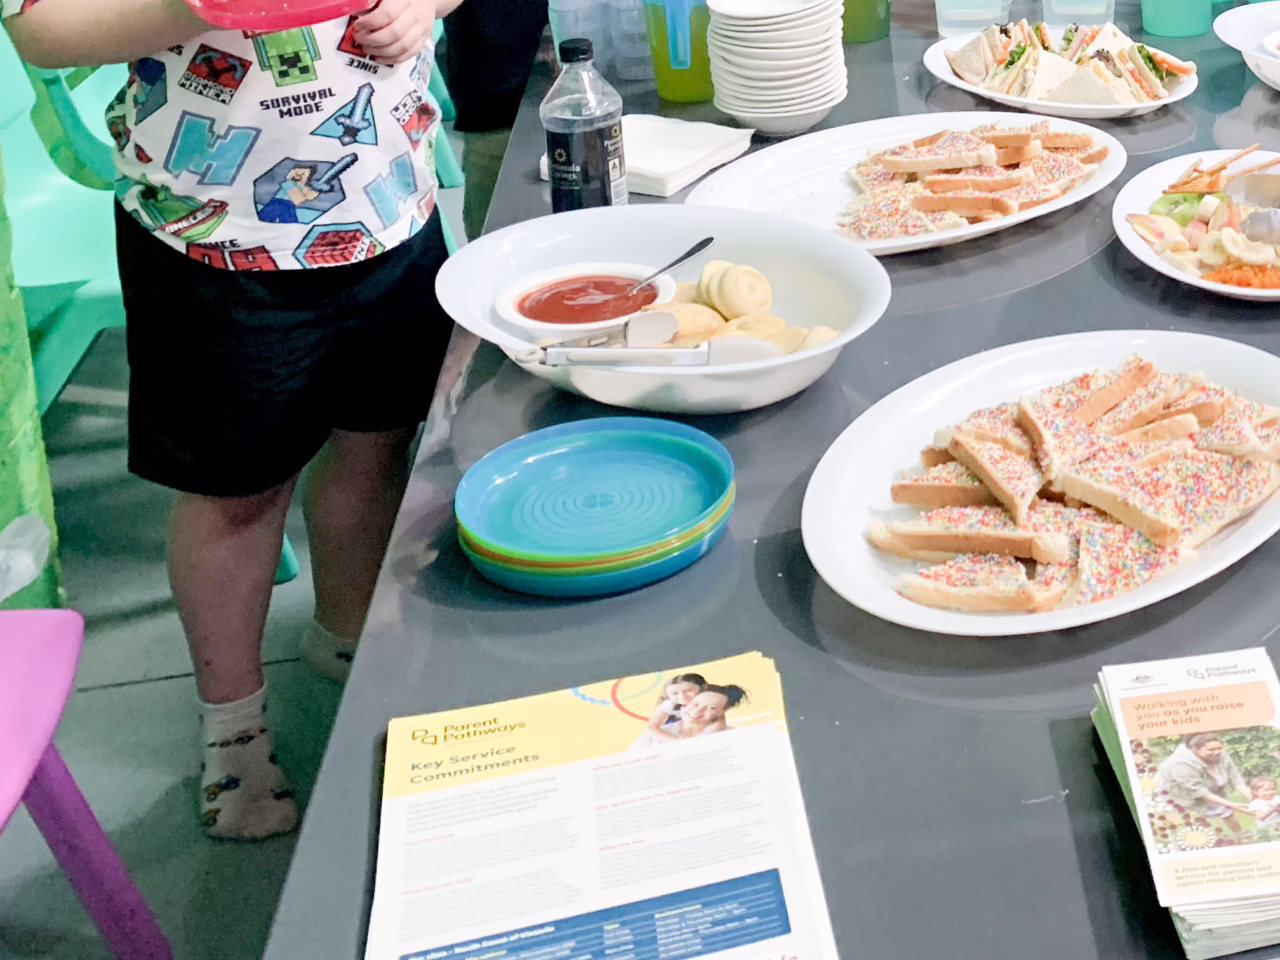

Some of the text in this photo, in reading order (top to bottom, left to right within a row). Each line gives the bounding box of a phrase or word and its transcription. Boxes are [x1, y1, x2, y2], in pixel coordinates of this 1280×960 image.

[178, 78, 233, 105] MINER
[259, 87, 337, 111] SURVIVAL
[279, 101, 324, 118] MODE
[1133, 694, 1219, 711] Walking with
[1136, 701, 1244, 721] you as you raise
[443, 717, 499, 734] Parent
[443, 722, 526, 742] Pathways
[1138, 715, 1201, 730] your kids
[411, 746, 516, 771] Key Service
[410, 754, 540, 784] Commitments
